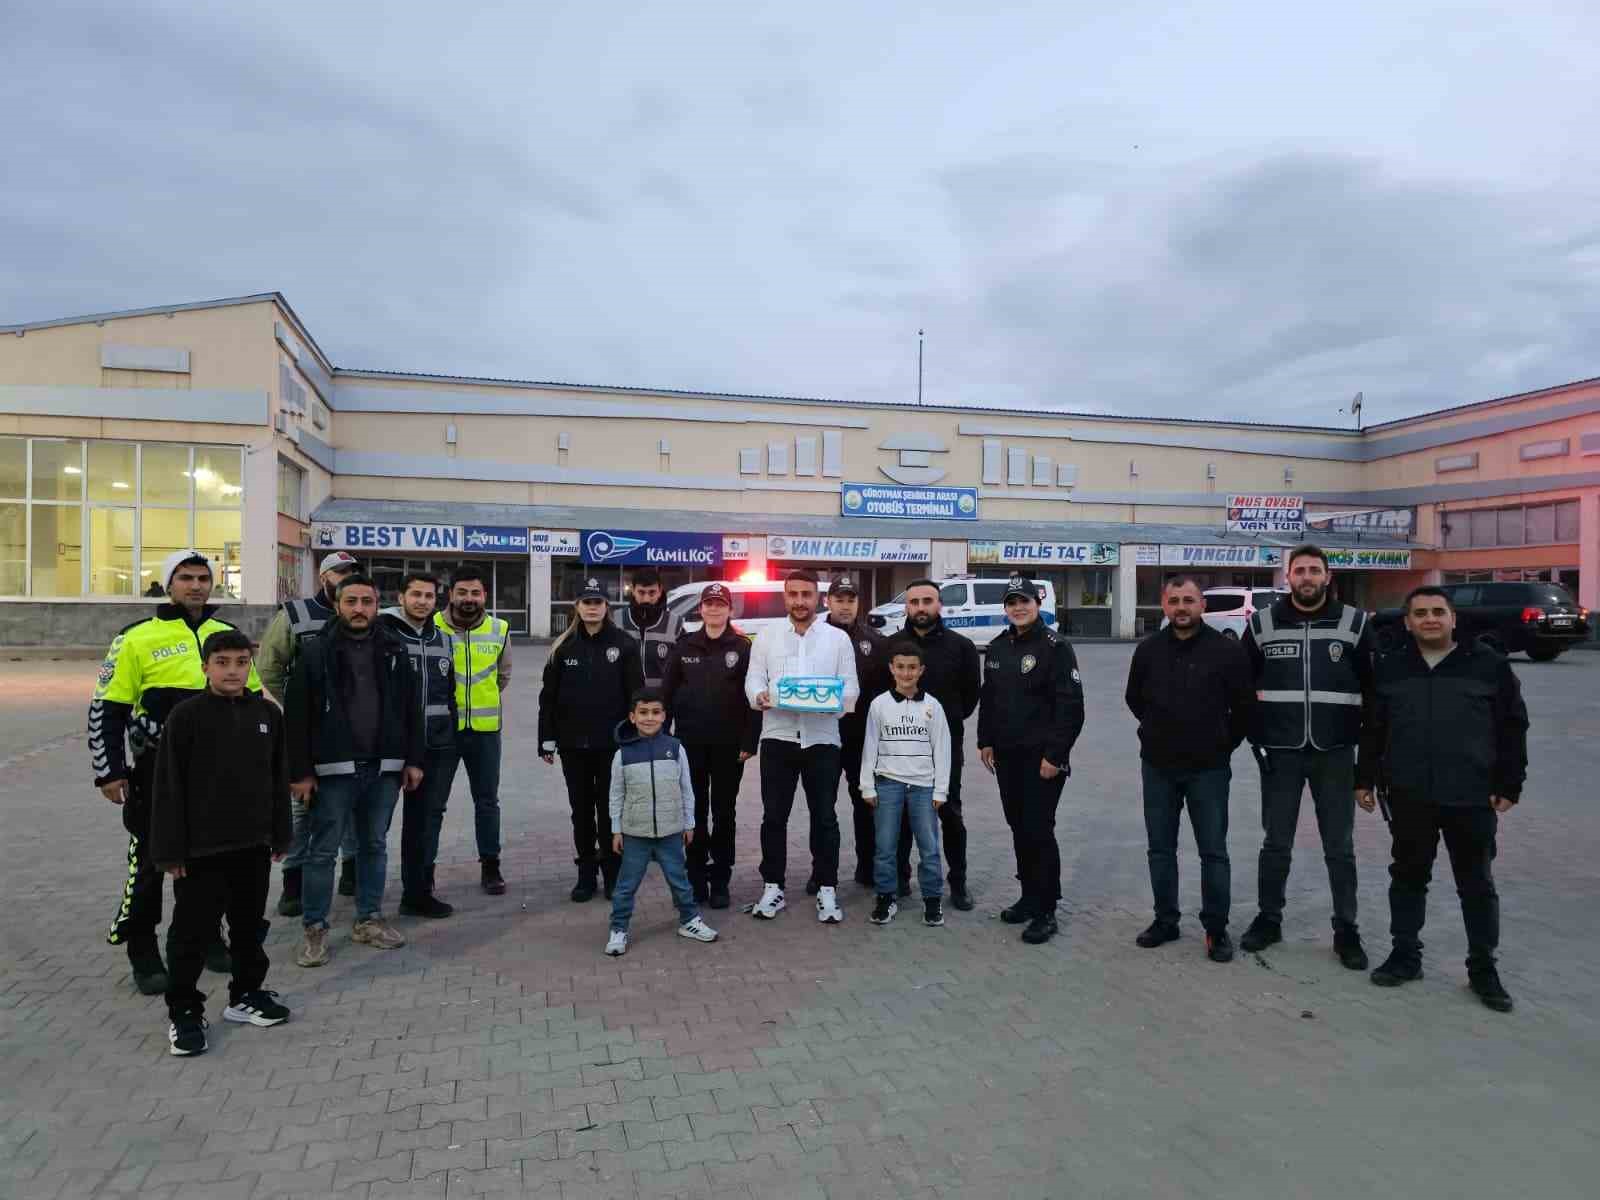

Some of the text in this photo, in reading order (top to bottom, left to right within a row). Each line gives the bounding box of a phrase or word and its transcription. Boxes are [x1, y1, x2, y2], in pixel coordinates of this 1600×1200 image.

[866, 500, 954, 516] OTOBÜS TERMİNALİ
[1239, 508, 1300, 519] METRO
[1240, 521, 1301, 531] VAN TUR
[345, 526, 457, 548] BEST VAN
[791, 539, 879, 558] VAN KALESİ
[1003, 542, 1087, 561] BİTLİS TAÇ
[884, 724, 928, 736] Emirates
